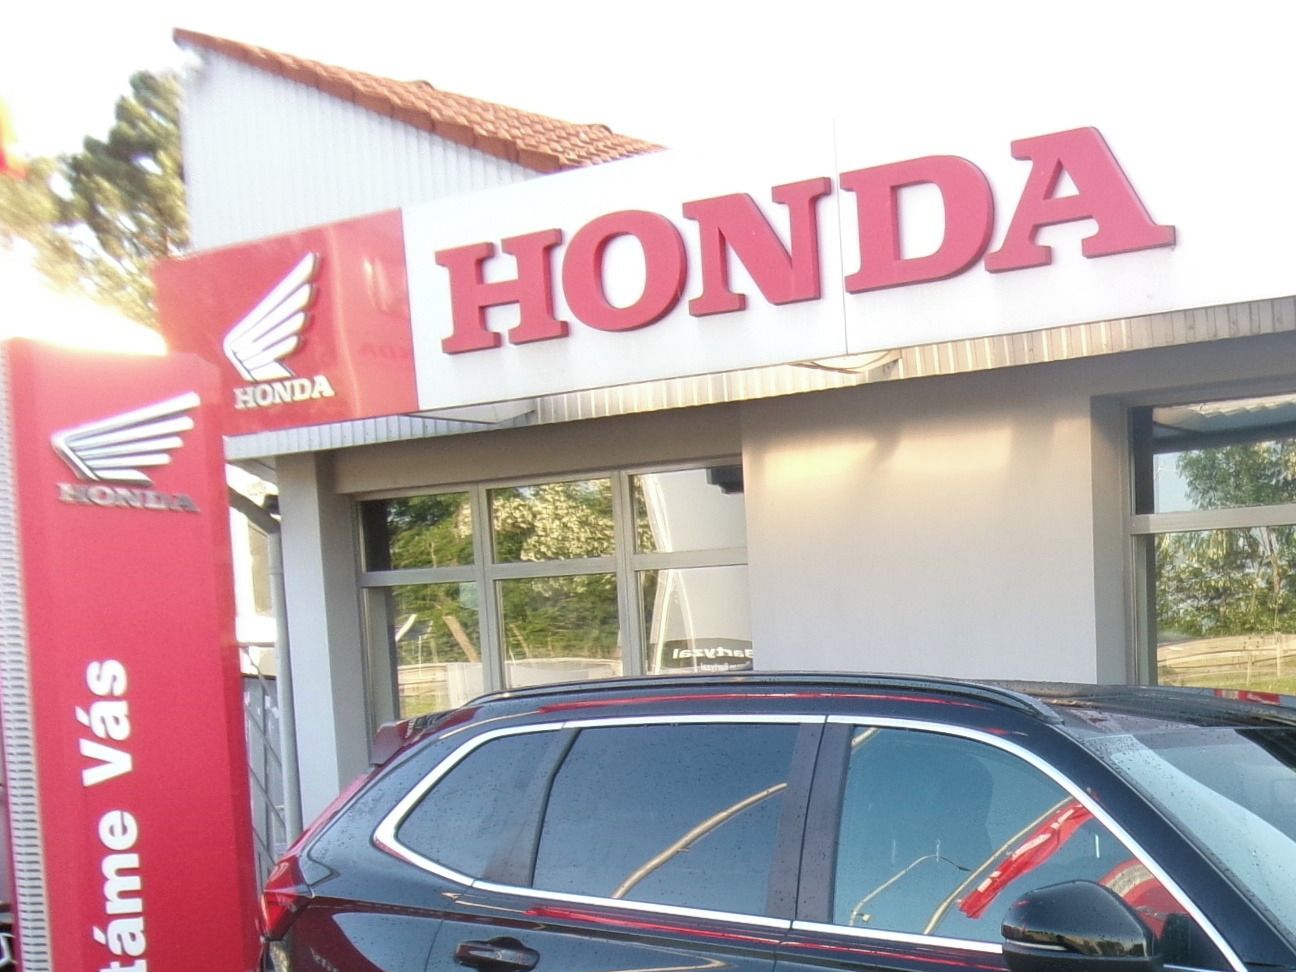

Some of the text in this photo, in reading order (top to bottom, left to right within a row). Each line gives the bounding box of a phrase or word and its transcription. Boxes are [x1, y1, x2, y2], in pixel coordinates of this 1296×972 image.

[434, 126, 1177, 354] HONDA
[233, 374, 335, 410] HONDA
[56, 482, 200, 513] HONDA
[75, 659, 134, 787] Vás
